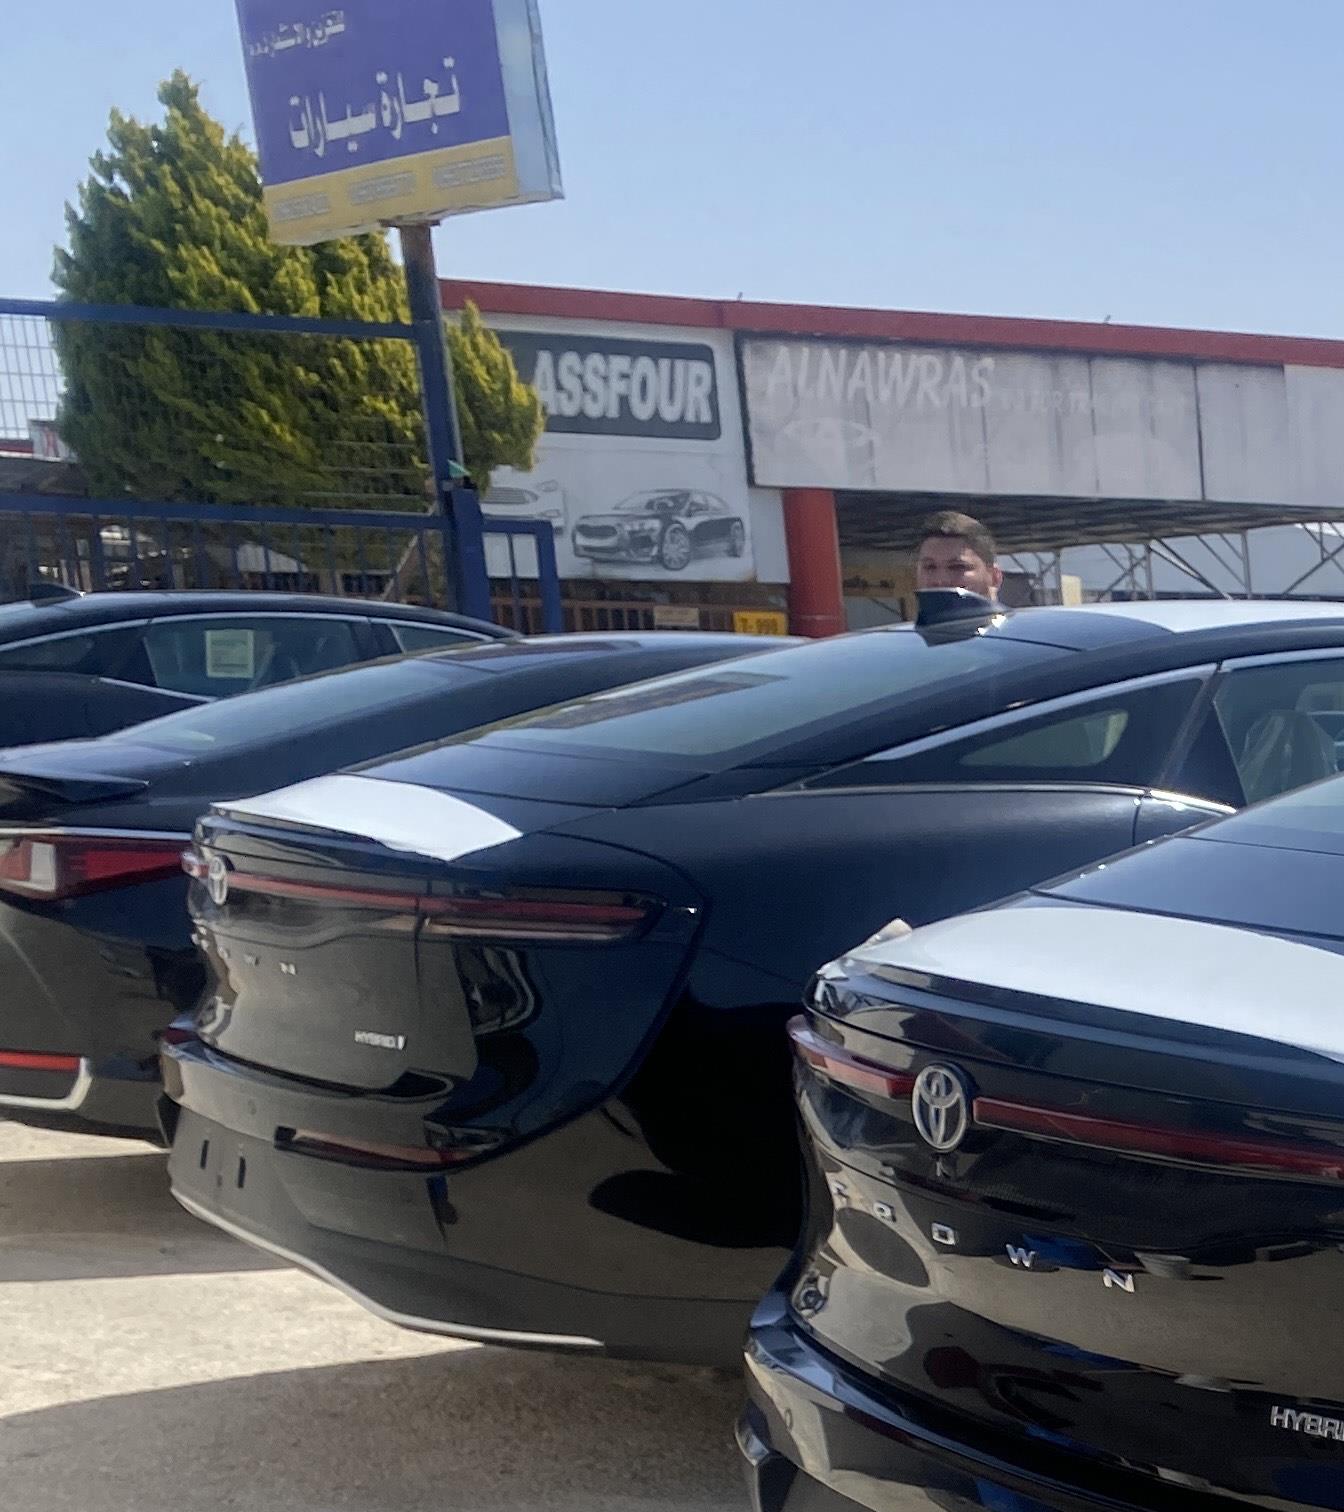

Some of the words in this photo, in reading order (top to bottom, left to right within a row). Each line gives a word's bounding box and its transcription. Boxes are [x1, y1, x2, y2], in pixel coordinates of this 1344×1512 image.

[289, 90, 377, 158] سيارات
[376, 56, 460, 140] تجارة
[533, 349, 714, 425] ASSFOUR
